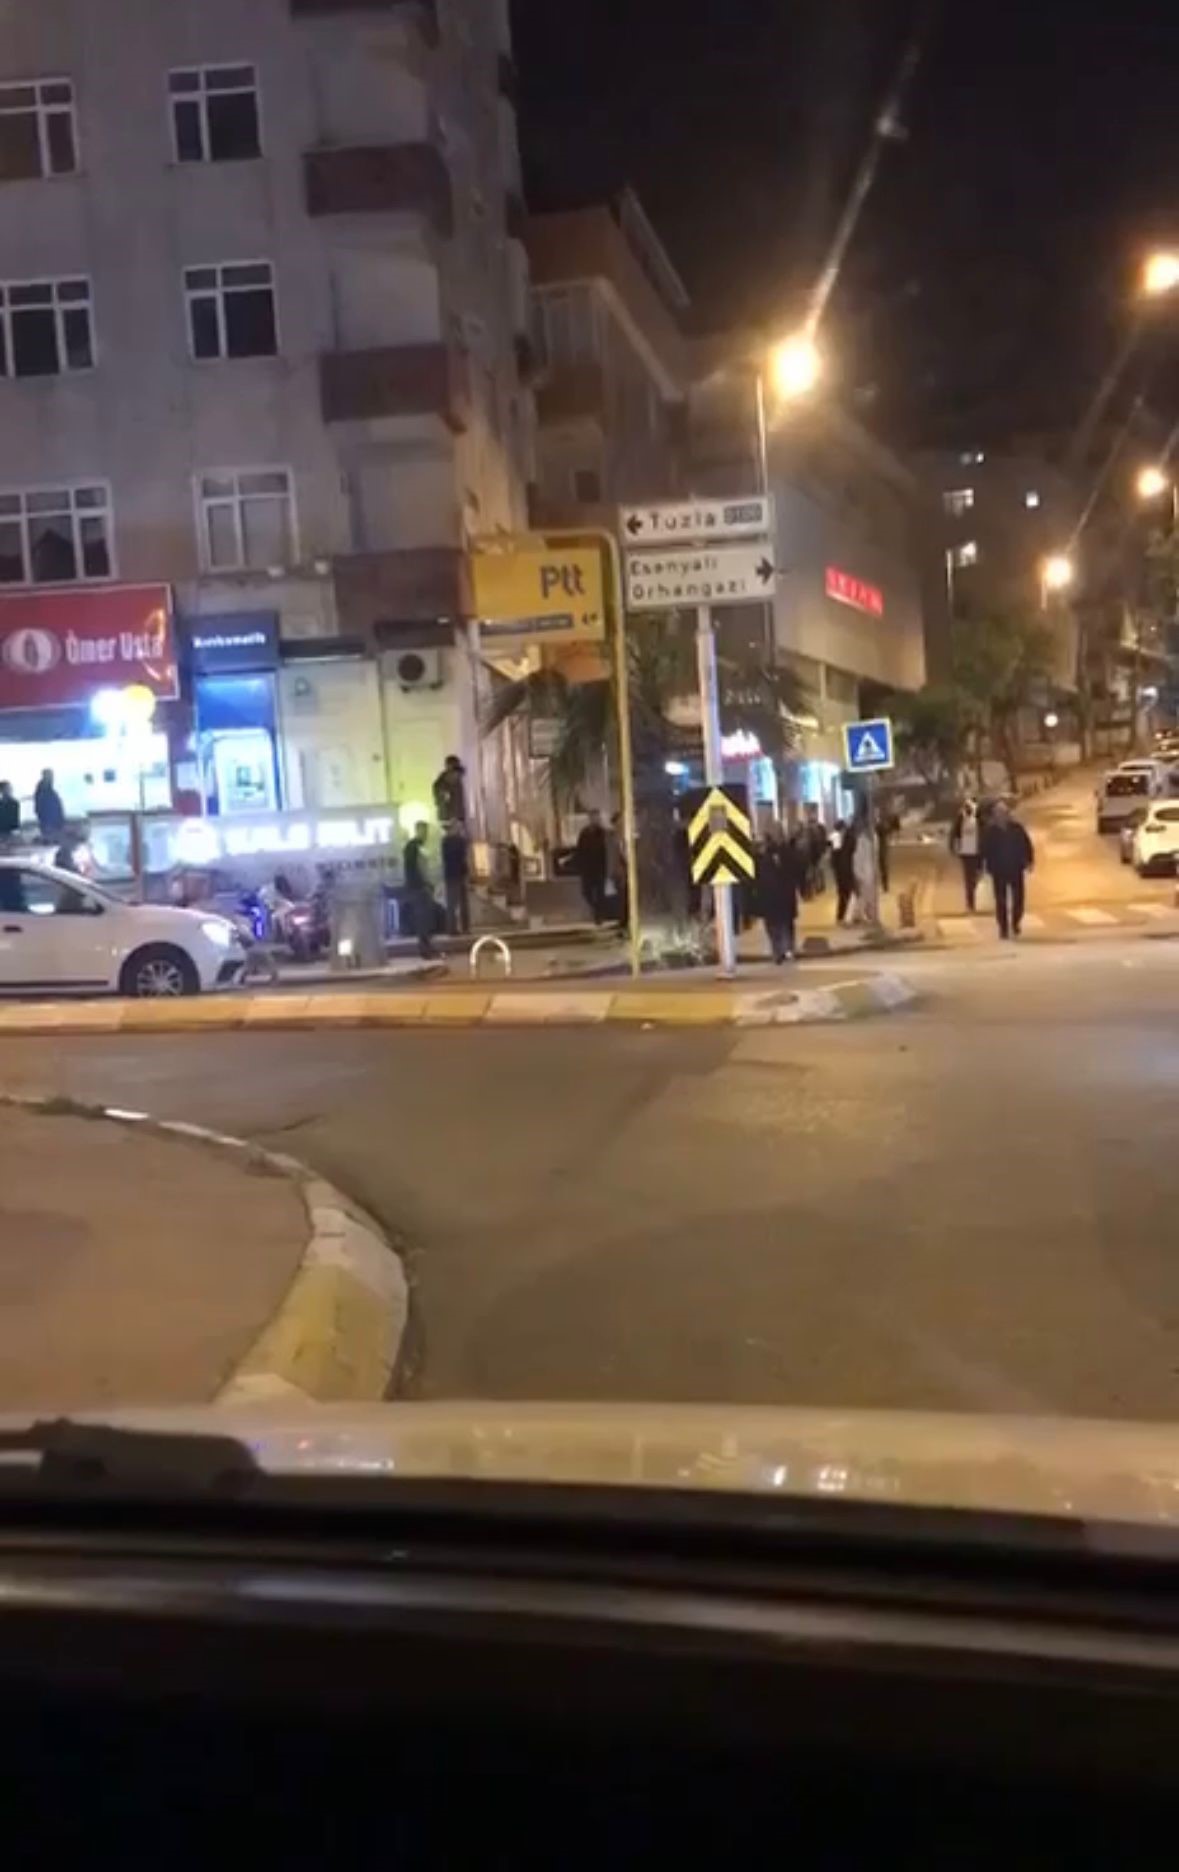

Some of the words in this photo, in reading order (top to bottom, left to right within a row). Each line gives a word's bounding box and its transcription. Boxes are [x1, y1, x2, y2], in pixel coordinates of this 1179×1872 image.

[650, 512, 716, 530] Tuzla
[632, 579, 746, 600] Orhangazi
[65, 629, 117, 664] Ömer
[119, 631, 163, 661] Usta
